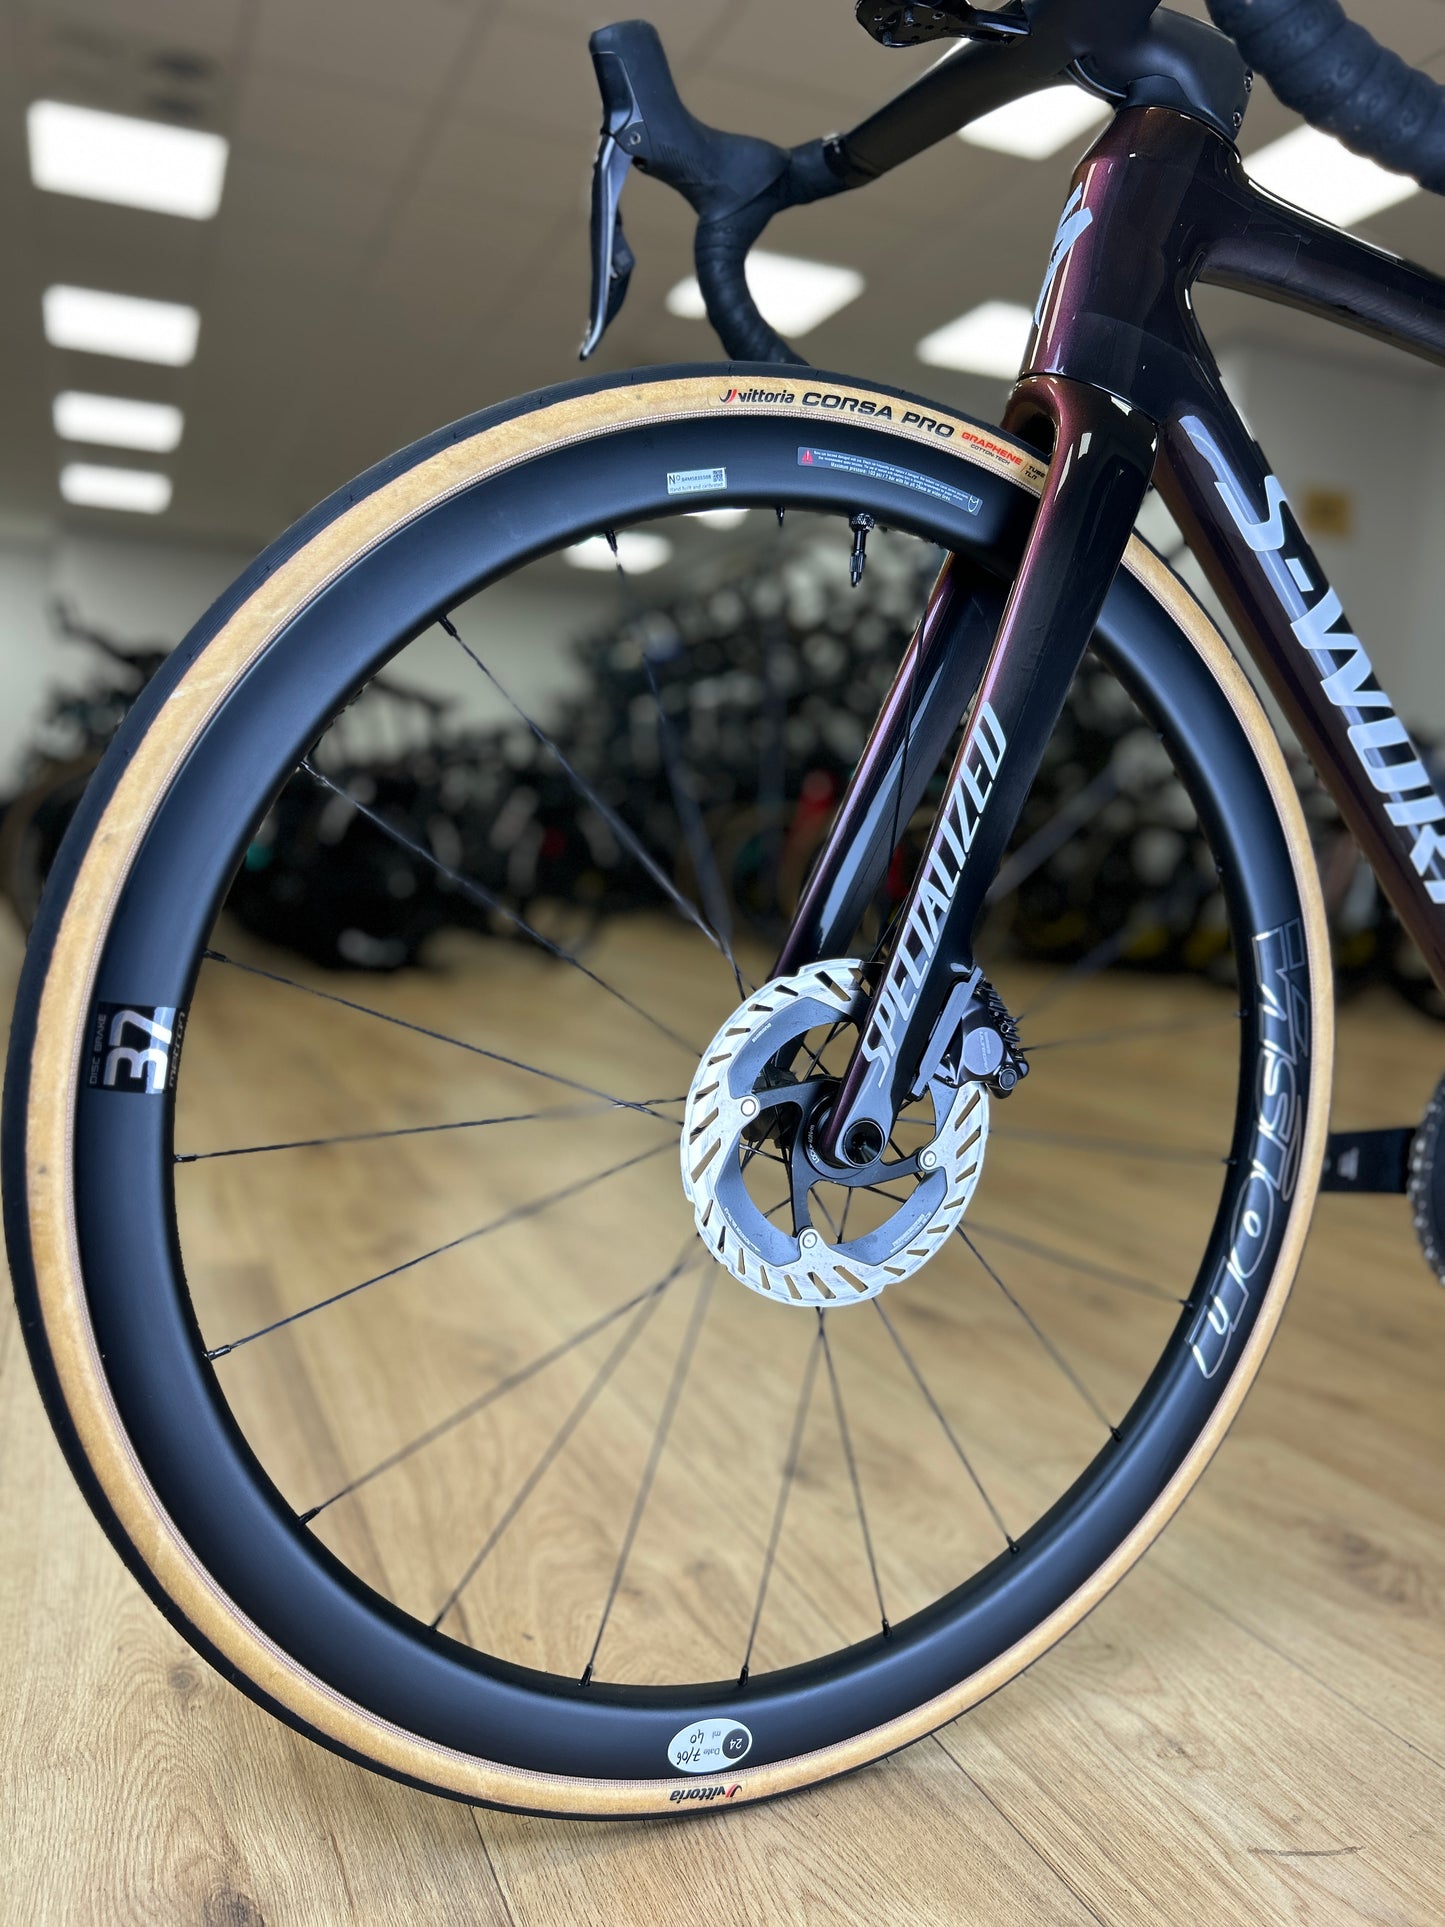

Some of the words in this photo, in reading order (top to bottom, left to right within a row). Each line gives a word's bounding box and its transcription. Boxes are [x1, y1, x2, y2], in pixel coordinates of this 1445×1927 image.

[738, 388, 795, 403] vittoria
[801, 391, 892, 420] CORSA
[900, 411, 955, 438] PRO
[961, 431, 1023, 465] GRAPHENE
[861, 701, 1007, 1088] SPECIALIZED
[94, 1014, 107, 1053] BRAKE
[103, 1009, 173, 1090] 37
[89, 1056, 101, 1085] DISC
[690, 1728, 705, 1744] 40
[703, 1747, 721, 1756] Date
[729, 1738, 743, 1750] 24
[669, 1785, 726, 1804] vittoria
